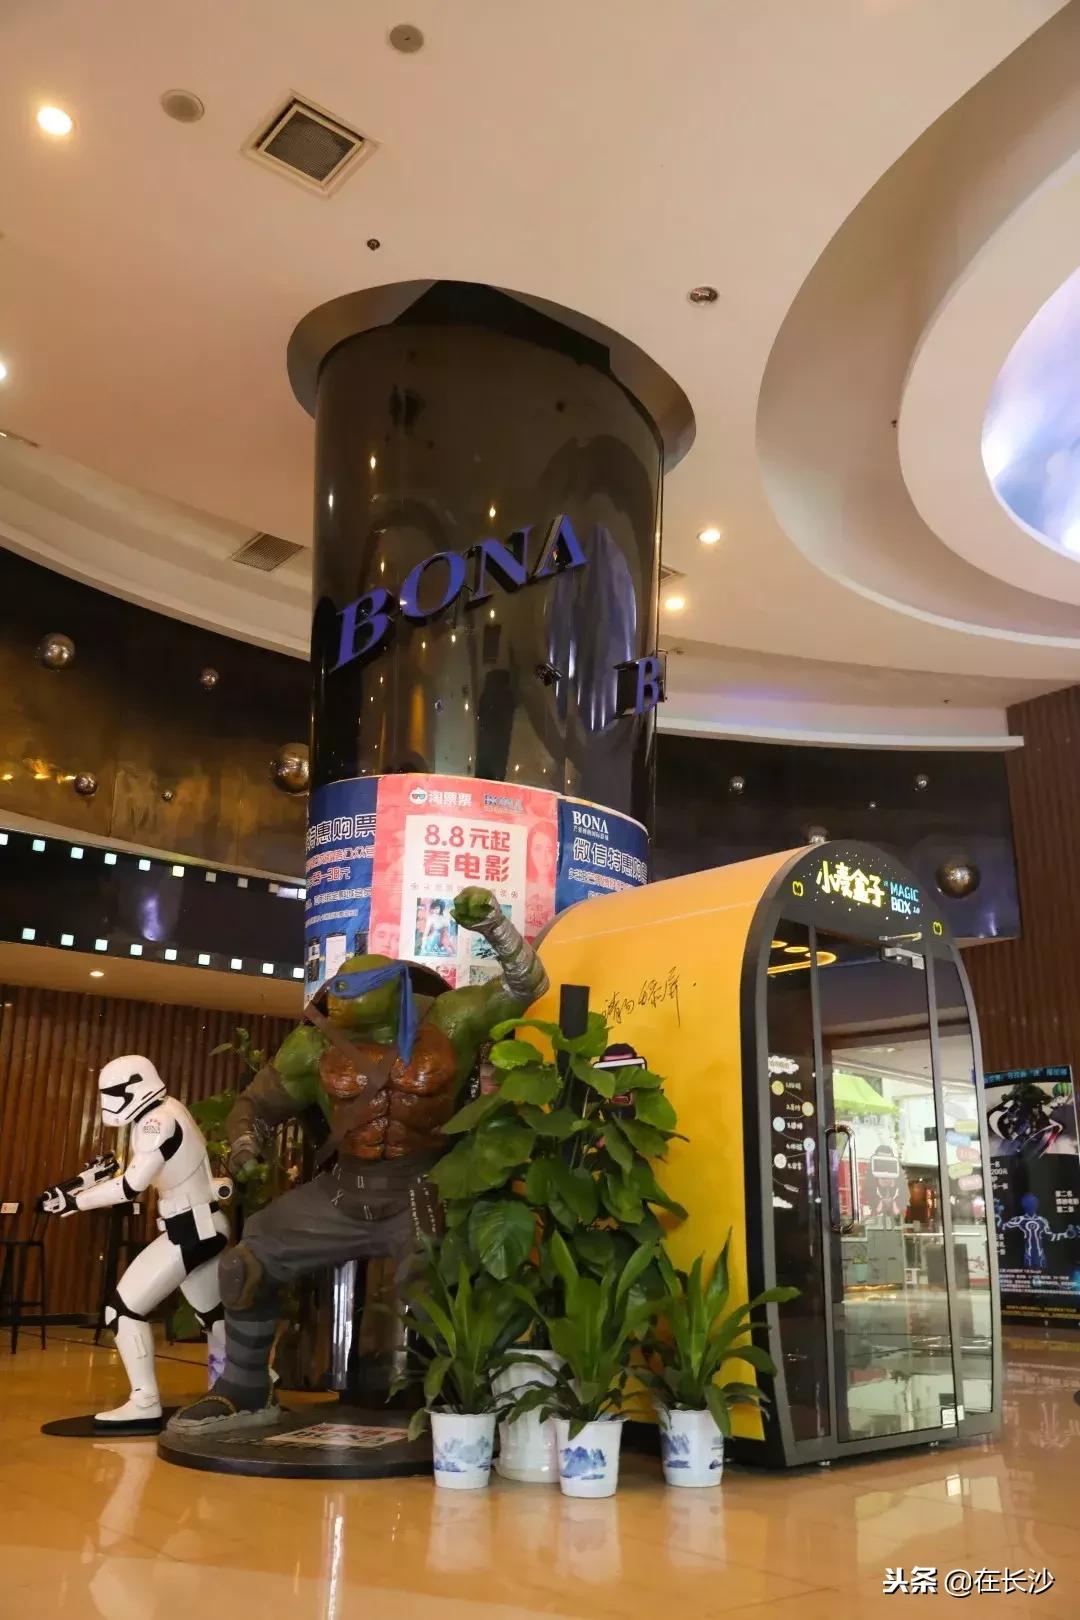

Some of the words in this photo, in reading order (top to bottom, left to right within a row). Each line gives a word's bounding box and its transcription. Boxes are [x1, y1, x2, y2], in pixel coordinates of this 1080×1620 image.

[330, 513, 590, 673] BONA
[572, 810, 609, 834] BONA
[424, 824, 511, 853] 8.8元起
[423, 849, 510, 883] 看电影
[890, 881, 920, 903] MAGIC
[891, 896, 912, 915] BOX
